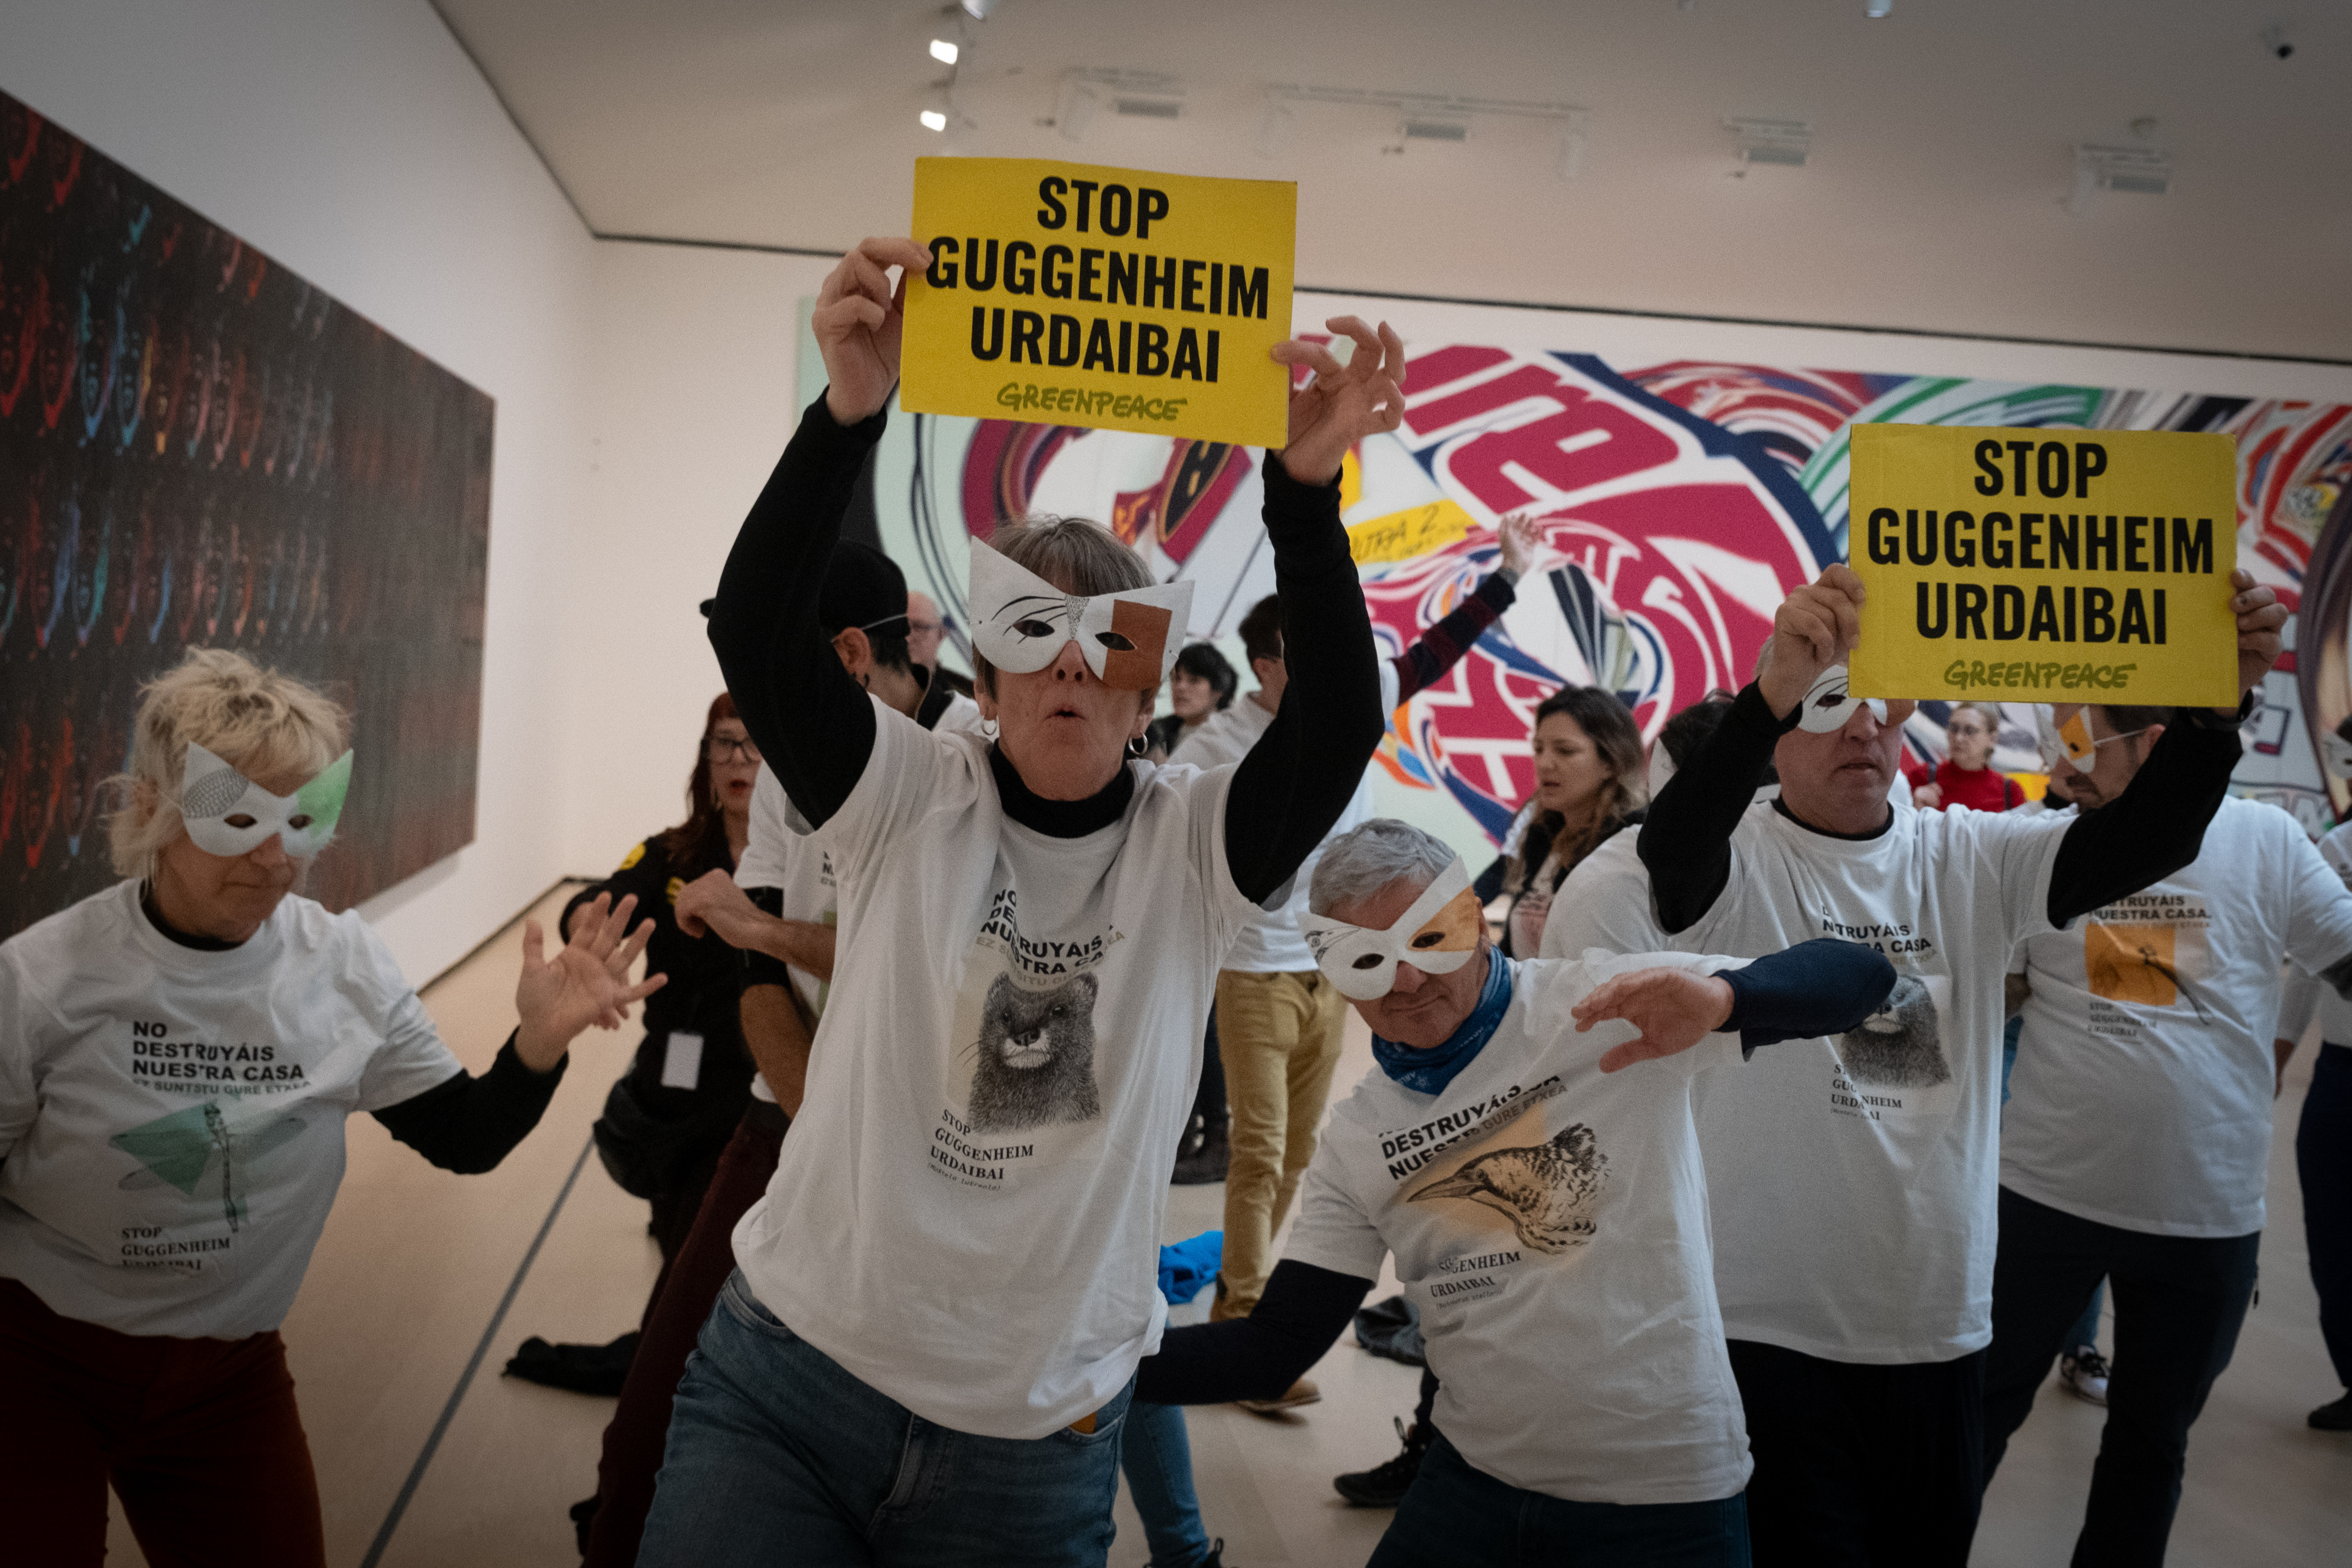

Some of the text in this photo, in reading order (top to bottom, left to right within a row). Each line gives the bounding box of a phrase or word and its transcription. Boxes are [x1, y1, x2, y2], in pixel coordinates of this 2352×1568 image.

[1038, 176, 1169, 239] STOP
[926, 237, 1269, 319] GUGGENHEIM
[970, 307, 1220, 383] URDAIBAI
[997, 383, 1187, 421] GREENPEACE
[1974, 439, 2107, 498] STOP
[1868, 507, 2213, 574] GUGGENHEIM
[1916, 581, 2166, 644] URDAIBAI
[1944, 659, 2137, 690] GREENPEACE
[994, 889, 1017, 907] NO
[979, 920, 1066, 974] NUTRA
[133, 1021, 167, 1038] NO
[133, 1040, 275, 1062] DESTRUYÁIS
[243, 1064, 304, 1082] CASA
[941, 1108, 971, 1137] STOP
[931, 1144, 1005, 1180] URDAIBAI
[934, 1126, 1034, 1162] GUGGENHEIM
[121, 1226, 162, 1240] STOP
[121, 1237, 230, 1257] GUGGENHEIM
[1430, 1276, 1496, 1298] URDAIBAI
